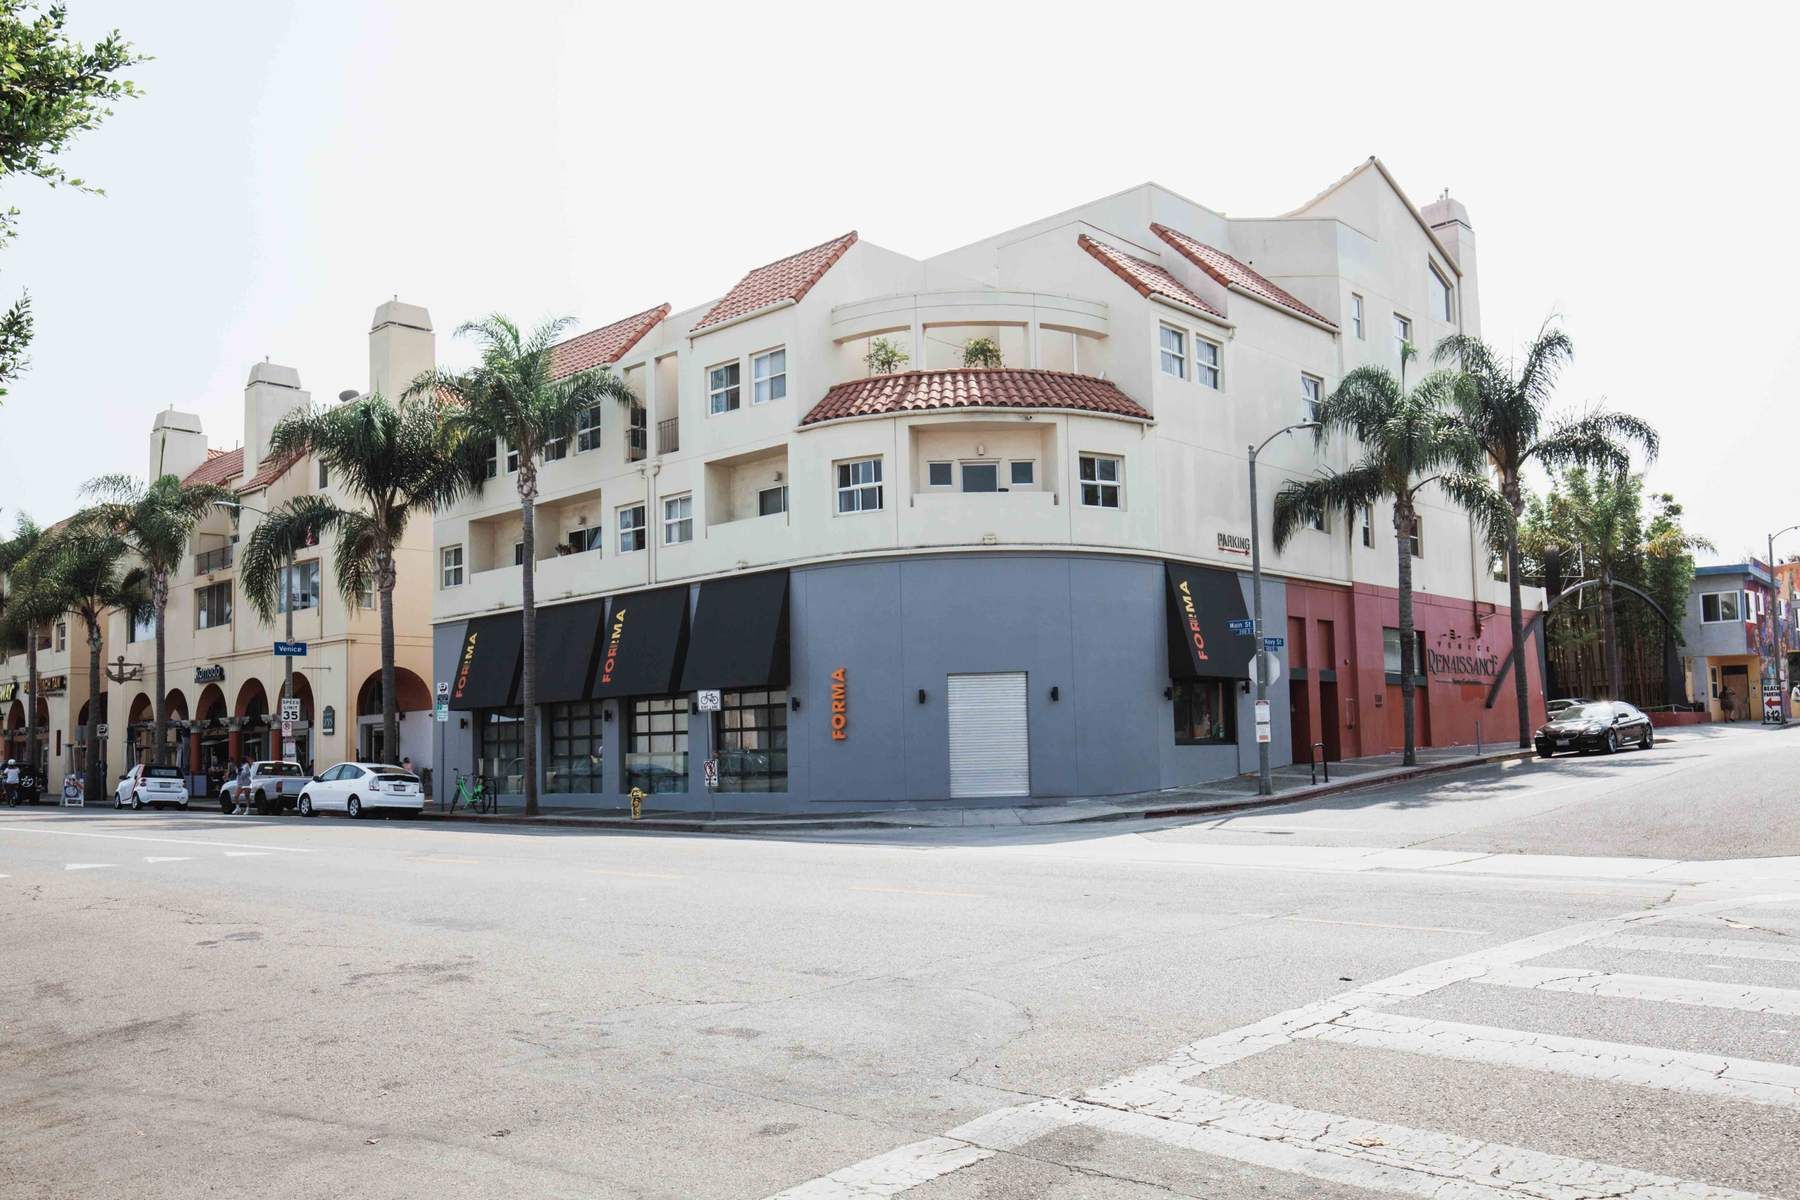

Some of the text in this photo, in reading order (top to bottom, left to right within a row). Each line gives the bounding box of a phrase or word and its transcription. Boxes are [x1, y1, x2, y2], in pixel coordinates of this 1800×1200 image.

[1217, 532, 1250, 550] PARKING
[278, 645, 302, 653] Venice
[1427, 648, 1498, 676] RENAISSANCE
[831, 666, 848, 741] FORMA
[283, 711, 299, 720] 35
[1766, 709, 1780, 721] $12
